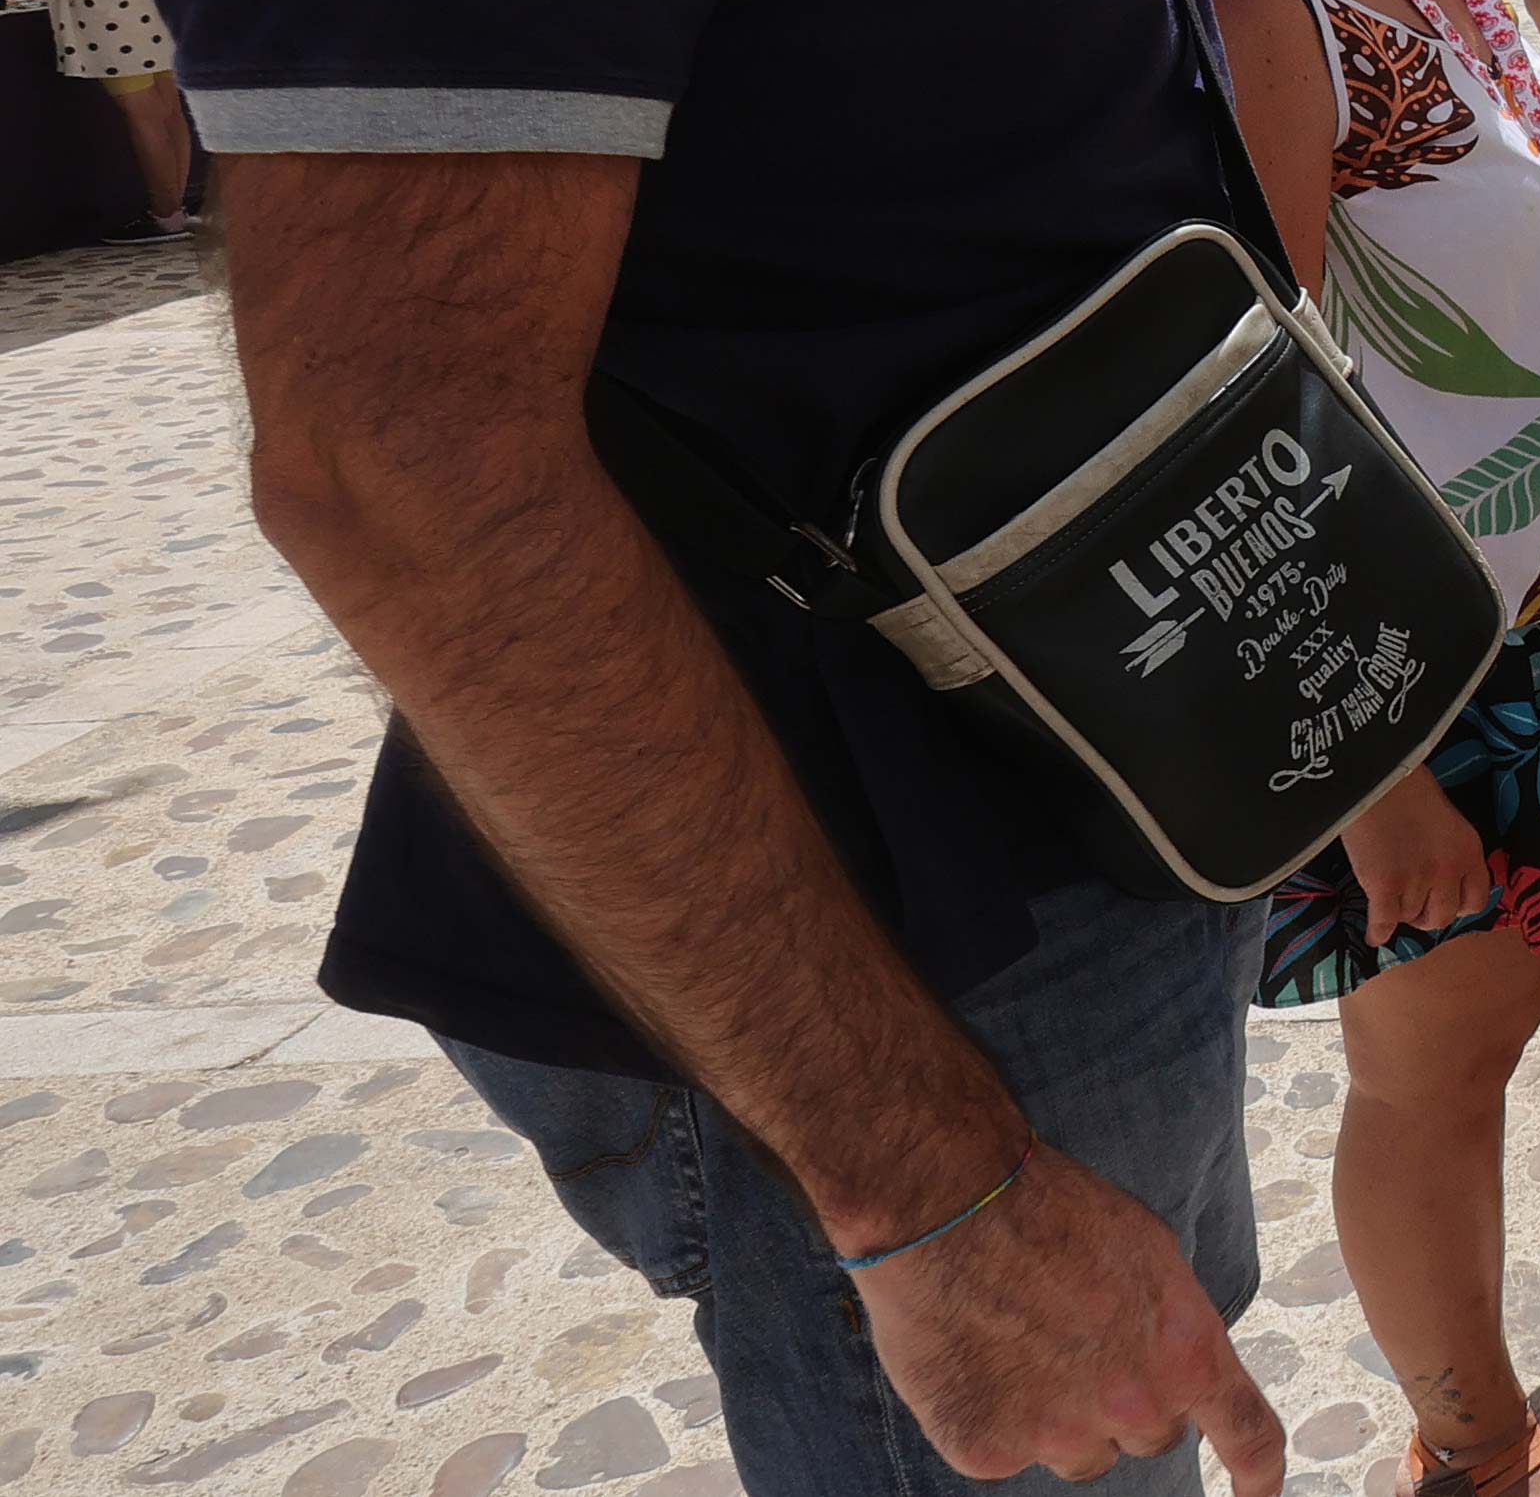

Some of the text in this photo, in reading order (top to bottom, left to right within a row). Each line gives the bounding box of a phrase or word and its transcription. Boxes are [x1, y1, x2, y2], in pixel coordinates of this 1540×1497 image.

[1109, 428, 1312, 618] LIBERTO
[1191, 496, 1316, 622] BUENOS
[1299, 634, 1359, 704] quality
